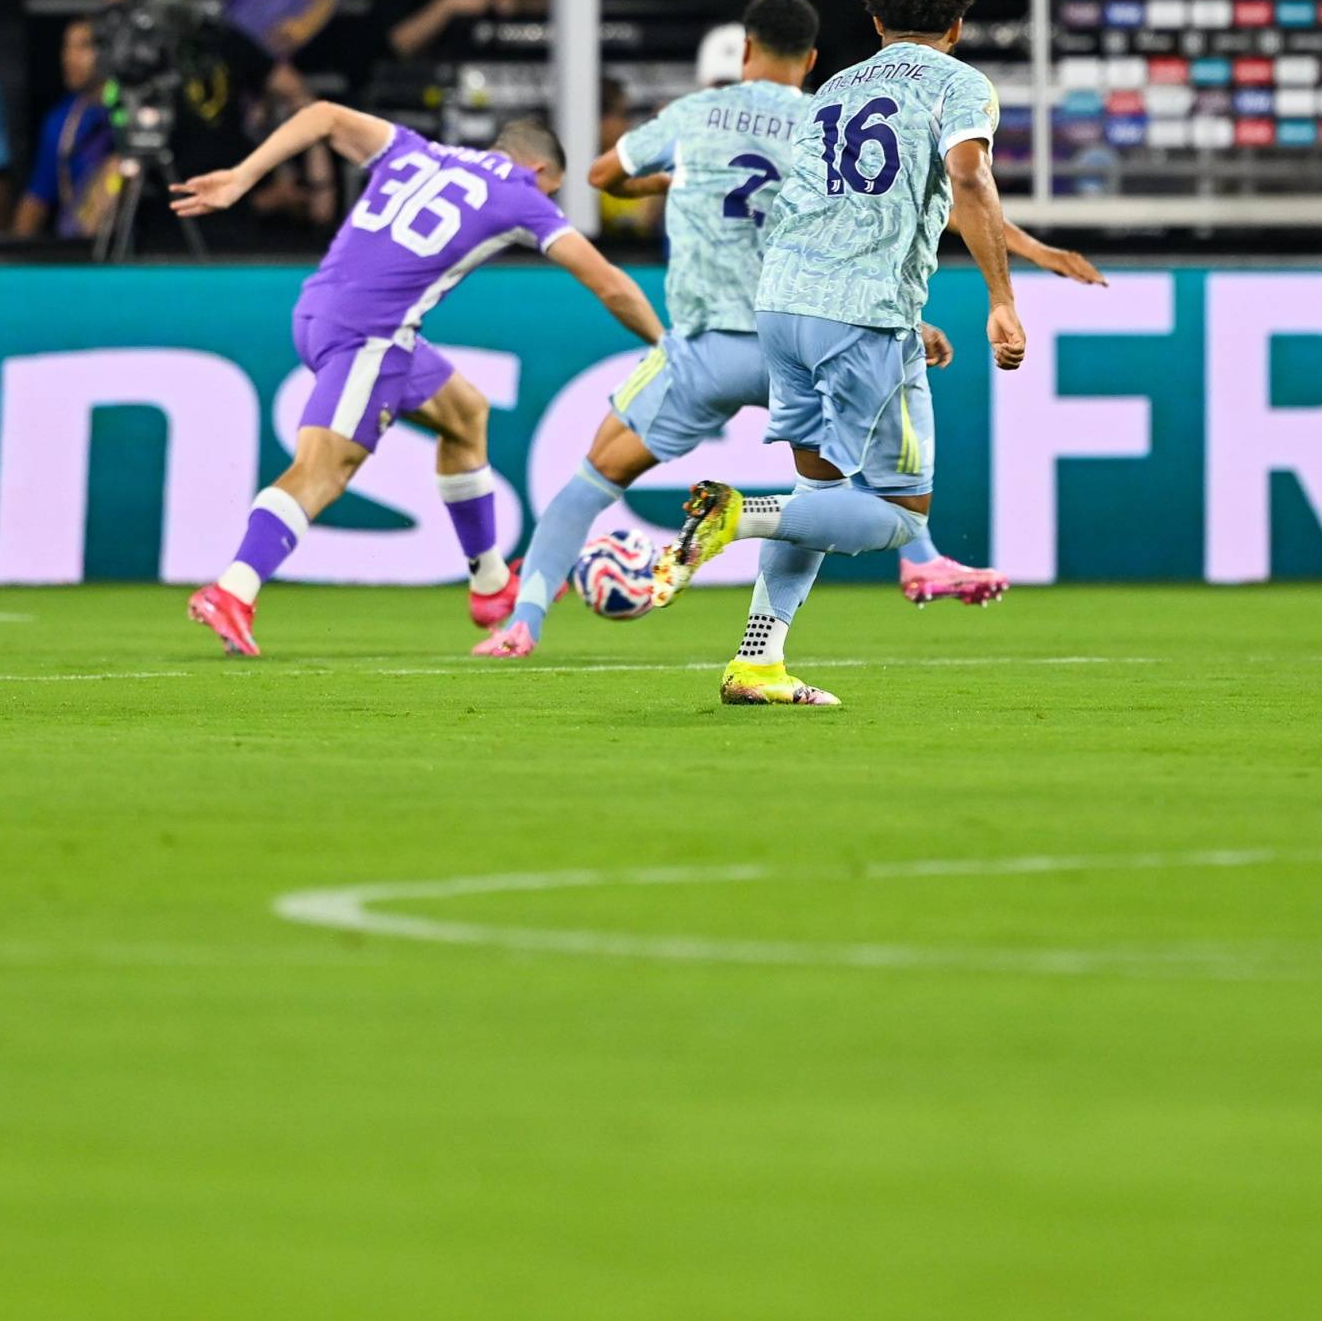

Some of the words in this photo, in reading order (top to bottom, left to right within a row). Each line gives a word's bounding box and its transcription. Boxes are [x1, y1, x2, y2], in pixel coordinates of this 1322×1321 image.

[723, 153, 782, 228] 2
[813, 96, 901, 197] 16
[351, 150, 489, 259] 36
